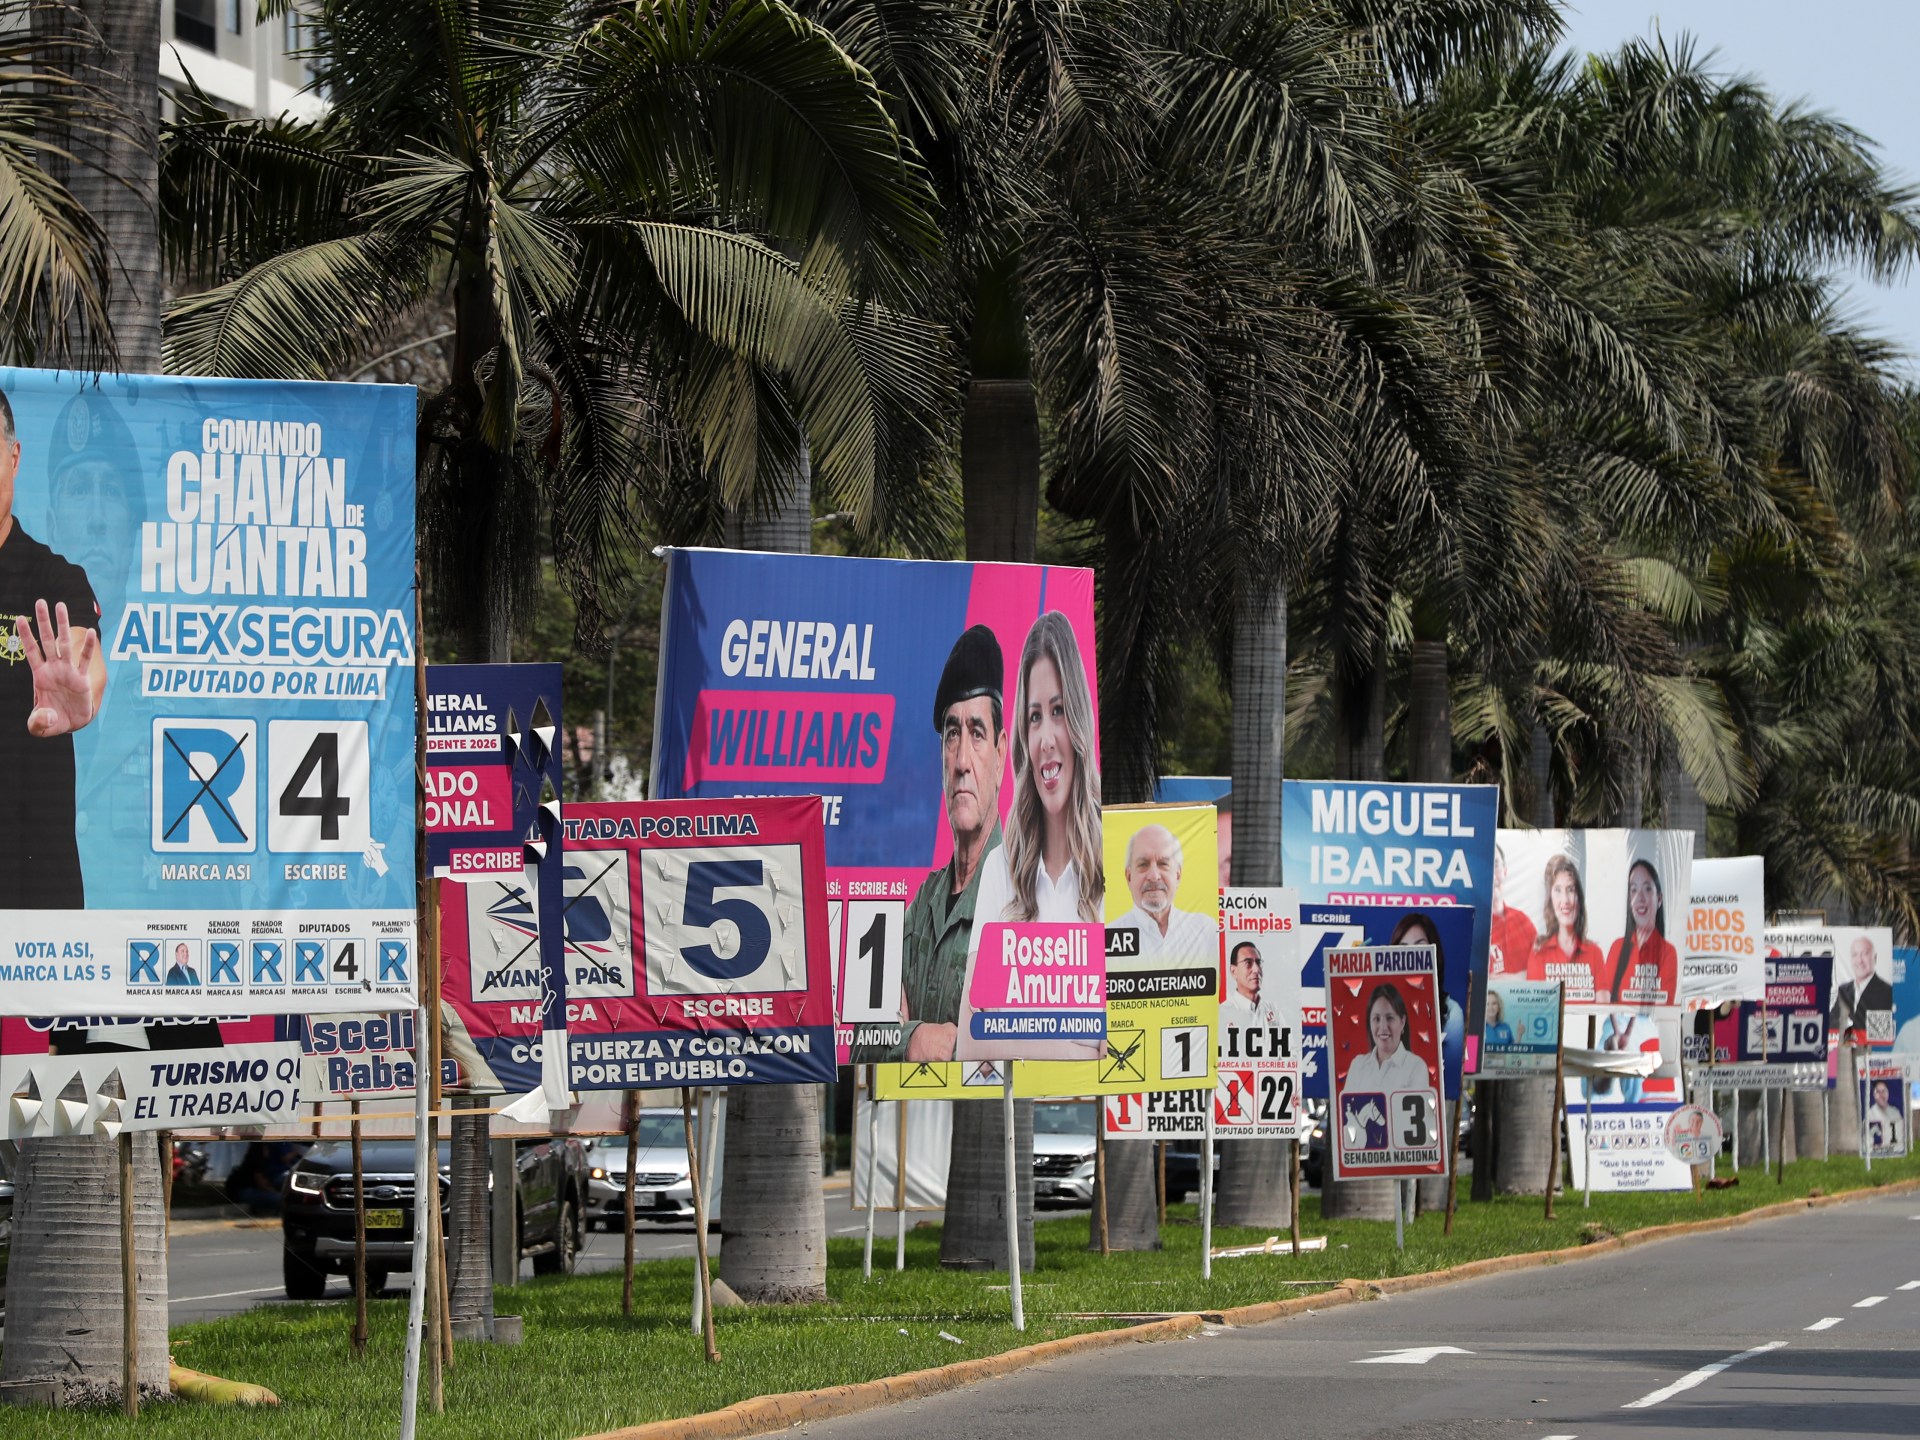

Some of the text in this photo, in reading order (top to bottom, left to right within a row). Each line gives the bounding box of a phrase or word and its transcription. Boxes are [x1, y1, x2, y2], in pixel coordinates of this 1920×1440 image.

[202, 418, 322, 457] COMANDO
[166, 451, 364, 528] CHAVÍN DE
[141, 522, 367, 597] HUÁNTAR
[111, 603, 415, 666] ALEX SEGURA
[720, 618, 877, 681] GENERAL
[147, 668, 380, 695] DIPUTADO POR LIMA
[415, 694, 488, 712] NERAL
[470, 739, 497, 749] 2026
[708, 708, 883, 768] WILLIAMS
[279, 732, 351, 841] 4
[1311, 789, 1475, 838] MIGUEL
[640, 814, 759, 837] POR LIMA
[161, 864, 347, 881] MARCA ASI ESCRIBE
[452, 852, 521, 870] ESCRIBE
[1310, 845, 1473, 888] IBARRA
[848, 881, 888, 896] ESCRIBE
[889, 878, 908, 895] ASÍ:
[1218, 893, 1267, 909] RACIÓN
[1707, 895, 1724, 903] CON
[299, 924, 350, 933] DIPUTADOS
[679, 859, 771, 980] 5
[1229, 912, 1292, 934] Limpias
[1311, 914, 1351, 923] ESCRIBE
[1002, 928, 1088, 967] Rosselli
[1686, 934, 1754, 955] UESTOS
[1786, 934, 1834, 944] NACIONAL
[15, 942, 94, 961] VOTA ASI,
[333, 943, 358, 980] 4
[858, 912, 887, 1009] 1
[1329, 950, 1434, 974] MARIA PARIONA
[0, 965, 111, 981] MARCA LAS 5
[575, 962, 622, 985] PAÍS
[1137, 975, 1207, 992] CATERIANO
[1005, 966, 1100, 1005] Amuruz
[1768, 986, 1805, 995] SENADO
[510, 997, 774, 1024] MACA ESCRIBE
[1110, 998, 1190, 1010] SENADOR NACIONAL
[984, 1018, 1102, 1033] PARLAMENTO ANDINO
[1110, 1016, 1198, 1028] MARCA ESCRIBE
[1533, 1016, 1548, 1038] 9
[1792, 1022, 1820, 1045] 10
[511, 1034, 810, 1063] CO FUERZA Y CORAZON
[856, 1029, 902, 1046] ANDINO
[1218, 1027, 1291, 1058] ICH
[1174, 1032, 1191, 1072] 1
[150, 1059, 269, 1087] TURISMO
[327, 1055, 460, 1092] Rabaa
[571, 1059, 754, 1084] POR EL PUEBLO.
[1257, 1061, 1285, 1069] ESCRIBE
[134, 1096, 159, 1119] EL
[170, 1089, 284, 1118] TRABAJO
[1261, 1075, 1294, 1120] 22
[1215, 1127, 1296, 1135] DIPUTADO DIPUTADO
[1402, 1095, 1427, 1147] 3
[1630, 1117, 1651, 1129] las
[1656, 1116, 1664, 1129] 5
[1344, 1149, 1440, 1165] SENADORA NACIONAL
